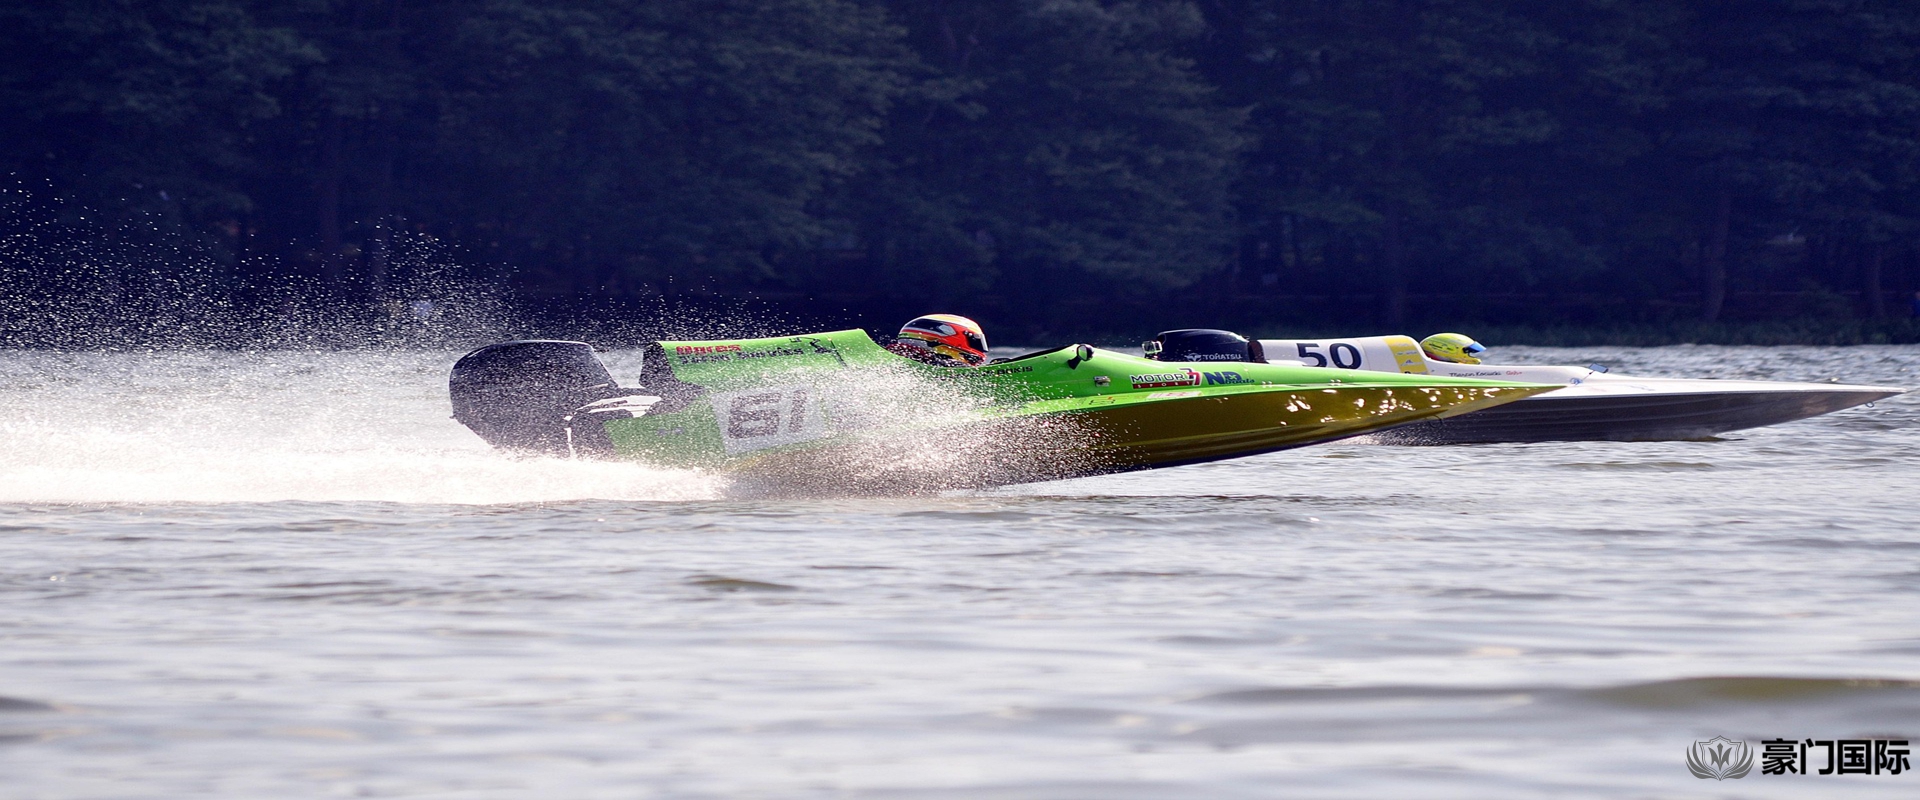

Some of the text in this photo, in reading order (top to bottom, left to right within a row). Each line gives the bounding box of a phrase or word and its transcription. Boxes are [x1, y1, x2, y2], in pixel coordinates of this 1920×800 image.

[1297, 342, 1362, 370] 50
[1131, 373, 1184, 383] MOTOR
[728, 388, 807, 439] 61
